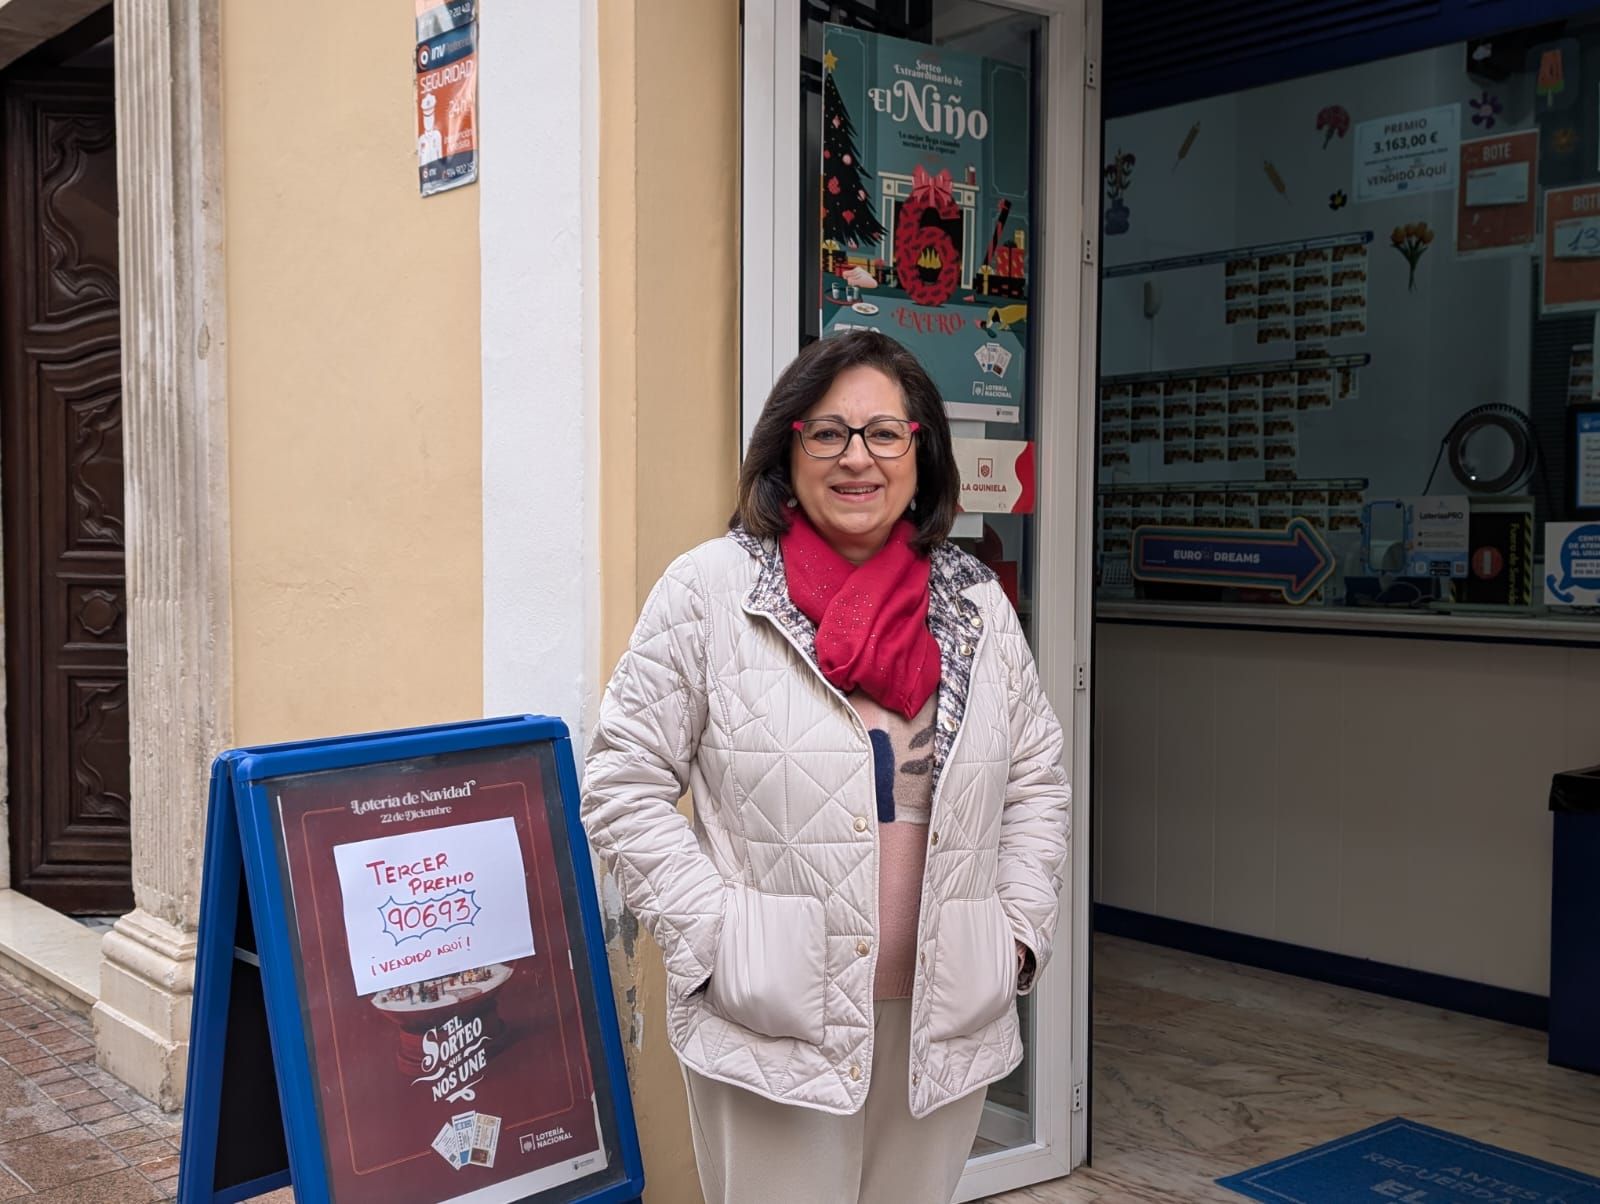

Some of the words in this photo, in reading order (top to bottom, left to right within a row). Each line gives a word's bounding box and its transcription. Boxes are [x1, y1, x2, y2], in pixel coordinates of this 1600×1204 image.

[420, 60, 474, 94] SEGURIDAD
[893, 63, 953, 85] Extraordinario
[954, 76, 964, 87] de
[915, 59, 942, 73] Sorteo
[868, 87, 892, 113] El
[892, 79, 989, 140] Niño
[1384, 118, 1428, 136] PREMIO
[1373, 133, 1427, 155] 3.163,00
[1430, 131, 1439, 144] €
[1482, 142, 1512, 161] BOTE
[1367, 169, 1416, 186] VENDIDO
[1418, 161, 1447, 178] AQUÍ
[985, 391, 1013, 399] NACIONAL
[962, 483, 971, 491] LA
[973, 483, 1007, 492] QUINIELA
[1173, 550, 1202, 561] EURO
[1214, 552, 1261, 564] DREAMS
[402, 792, 419, 806] de
[420, 779, 476, 803] Navidad
[380, 814, 393, 824] 22
[393, 811, 405, 822] de
[404, 805, 453, 822] Diciembre
[366, 853, 449, 886] TERCER
[408, 871, 474, 896] PREMIO
[387, 897, 471, 932] 90693
[441, 1015, 463, 1036] EL
[421, 1016, 482, 1073] SORTEO
[448, 1053, 462, 1068] QUE
[432, 1070, 458, 1102] NOS
[458, 1048, 487, 1083] UNE
[535, 1126, 565, 1141] LOTERÍA
[536, 1132, 573, 1149] NACIONAL
